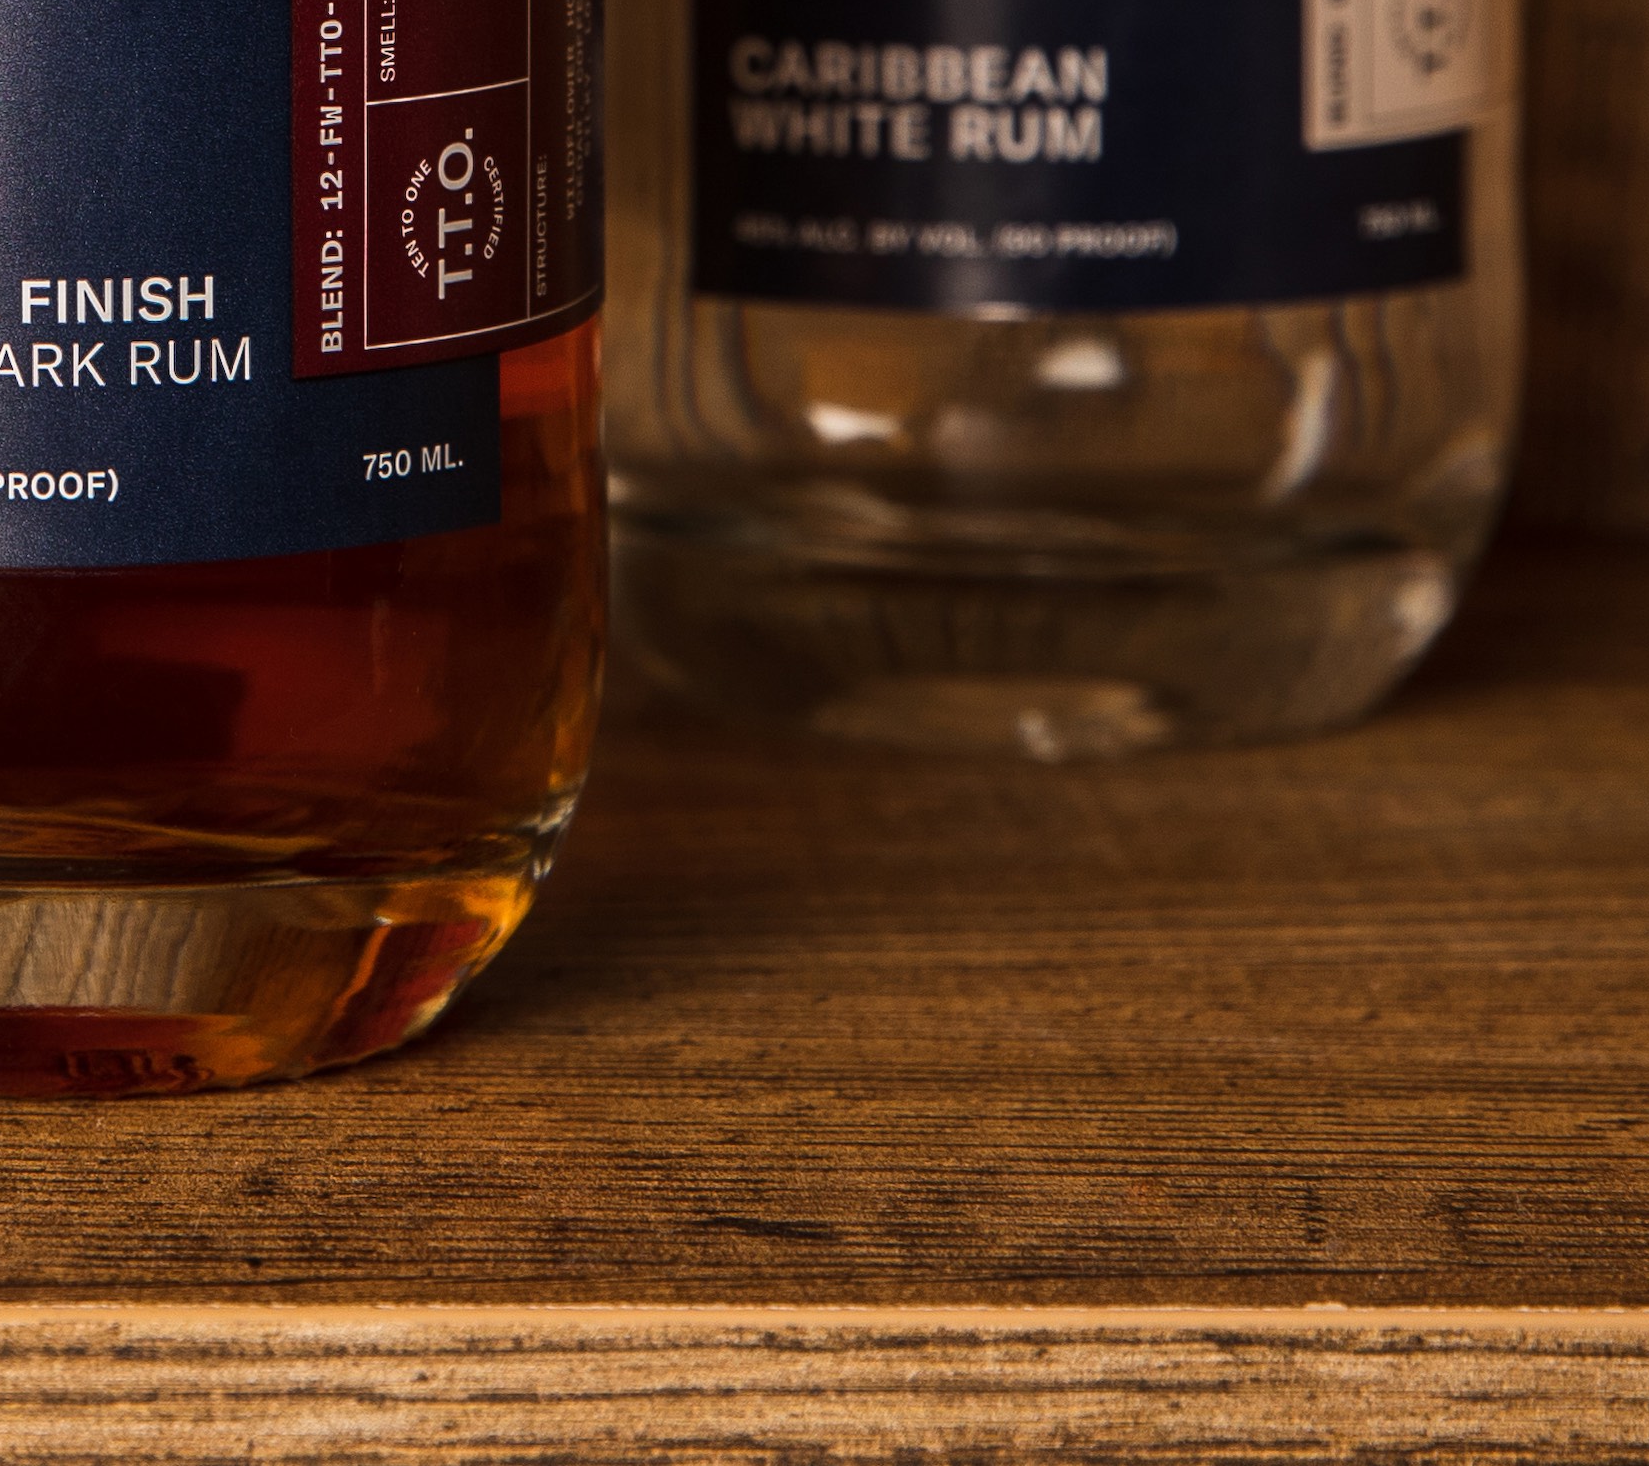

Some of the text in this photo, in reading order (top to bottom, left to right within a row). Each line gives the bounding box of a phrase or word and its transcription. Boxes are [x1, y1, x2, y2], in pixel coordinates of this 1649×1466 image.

[381, 0, 396, 82] SMELL:
[728, 35, 1108, 104] CARIBBEAN
[729, 99, 1103, 163] WHITE RUM
[402, 159, 432, 278] TEN TO ONE
[438, 128, 473, 299] T.T.O.
[484, 156, 504, 259] CERTIFIED
[536, 154, 546, 296] STRUCTURE:
[20, 276, 215, 324] FINISH
[320, 230, 343, 352] BLEND:
[130, 336, 252, 386] RUM
[363, 443, 463, 481] 750 ML.
